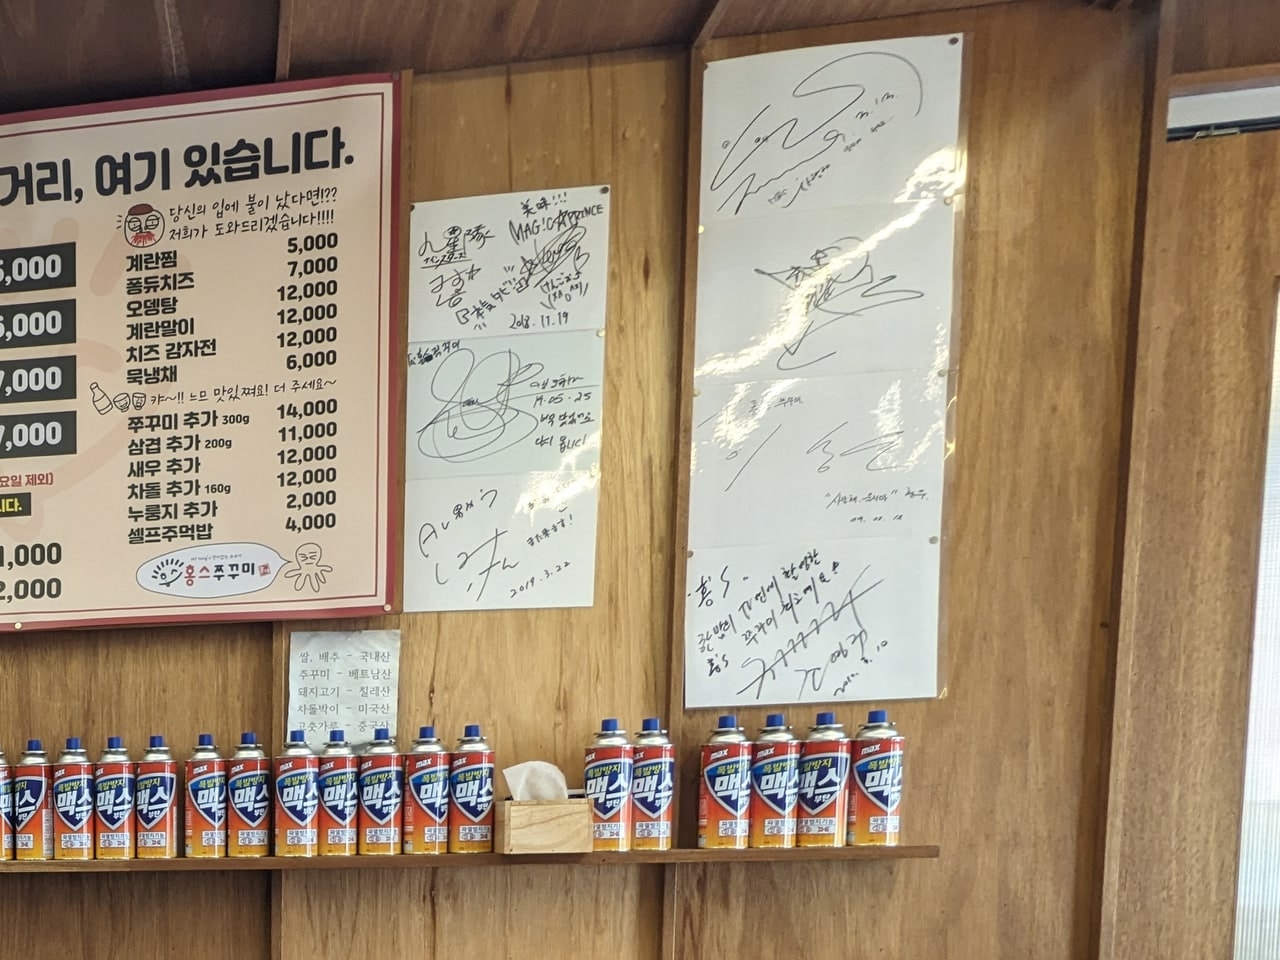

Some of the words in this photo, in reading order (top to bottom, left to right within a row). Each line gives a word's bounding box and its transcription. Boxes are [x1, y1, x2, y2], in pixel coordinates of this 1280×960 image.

[95, 147, 170, 197] 여기
[183, 127, 355, 189] 있습니다.
[170, 204, 206, 222] 당신의
[212, 200, 239, 219] 입에
[245, 194, 269, 216] 불이
[276, 187, 338, 209] 났다면!??
[169, 226, 208, 241] 저희가
[214, 210, 335, 237] 도와드리겠습니다!!!!
[126, 251, 177, 272] 계란찜
[287, 233, 338, 254] 5,000
[126, 272, 195, 295] 퐁듀치즈
[287, 256, 338, 277] 7,000
[277, 280, 338, 302] 12,000
[126, 318, 195, 341] 계란말이
[277, 304, 338, 326] 12,000
[126, 343, 160, 364] 치즈
[165, 339, 217, 360] 감자전
[277, 327, 338, 349] 12,000
[126, 366, 178, 385] 묵냉채
[286, 350, 338, 372] 6,000
[274, 382, 286, 393] 더
[127, 413, 178, 433] 쭈꾸미
[183, 411, 218, 428] 추가
[221, 414, 250, 427] 300g
[276, 399, 338, 420] 14,000
[127, 437, 161, 455] 삼겹
[166, 434, 201, 451] 추가
[204, 438, 232, 451] 200g
[278, 422, 338, 443] 11,000
[127, 460, 161, 478] 새우
[166, 457, 201, 475] 추가
[276, 445, 337, 465] 12,000
[25, 472, 54, 486] 제외)
[127, 483, 161, 500] 차돌
[166, 480, 201, 497] 추가
[204, 483, 231, 495] 160g
[276, 467, 337, 488] 12,000
[127, 504, 178, 522] 누룽지
[183, 501, 218, 518] 추가
[286, 490, 337, 510] 2,000
[127, 524, 213, 545] 셀프주먹밥
[285, 513, 336, 533] 4,000
[319, 651, 340, 663] 배추
[360, 651, 391, 663] 국내산
[348, 669, 392, 680] 베트남산
[298, 686, 340, 698] 돼지고기
[359, 686, 391, 698] 칠레산
[297, 704, 339, 715] 차돌박이
[358, 703, 390, 715] 미국산
[97, 788, 131, 814] 맥스
[234, 784, 268, 812] 맥스
[363, 781, 400, 809] 맥스
[456, 778, 493, 807] 맥스
[587, 773, 628, 803] 맥스
[633, 772, 672, 802] 맥스
[57, 789, 92, 816] 맥스
